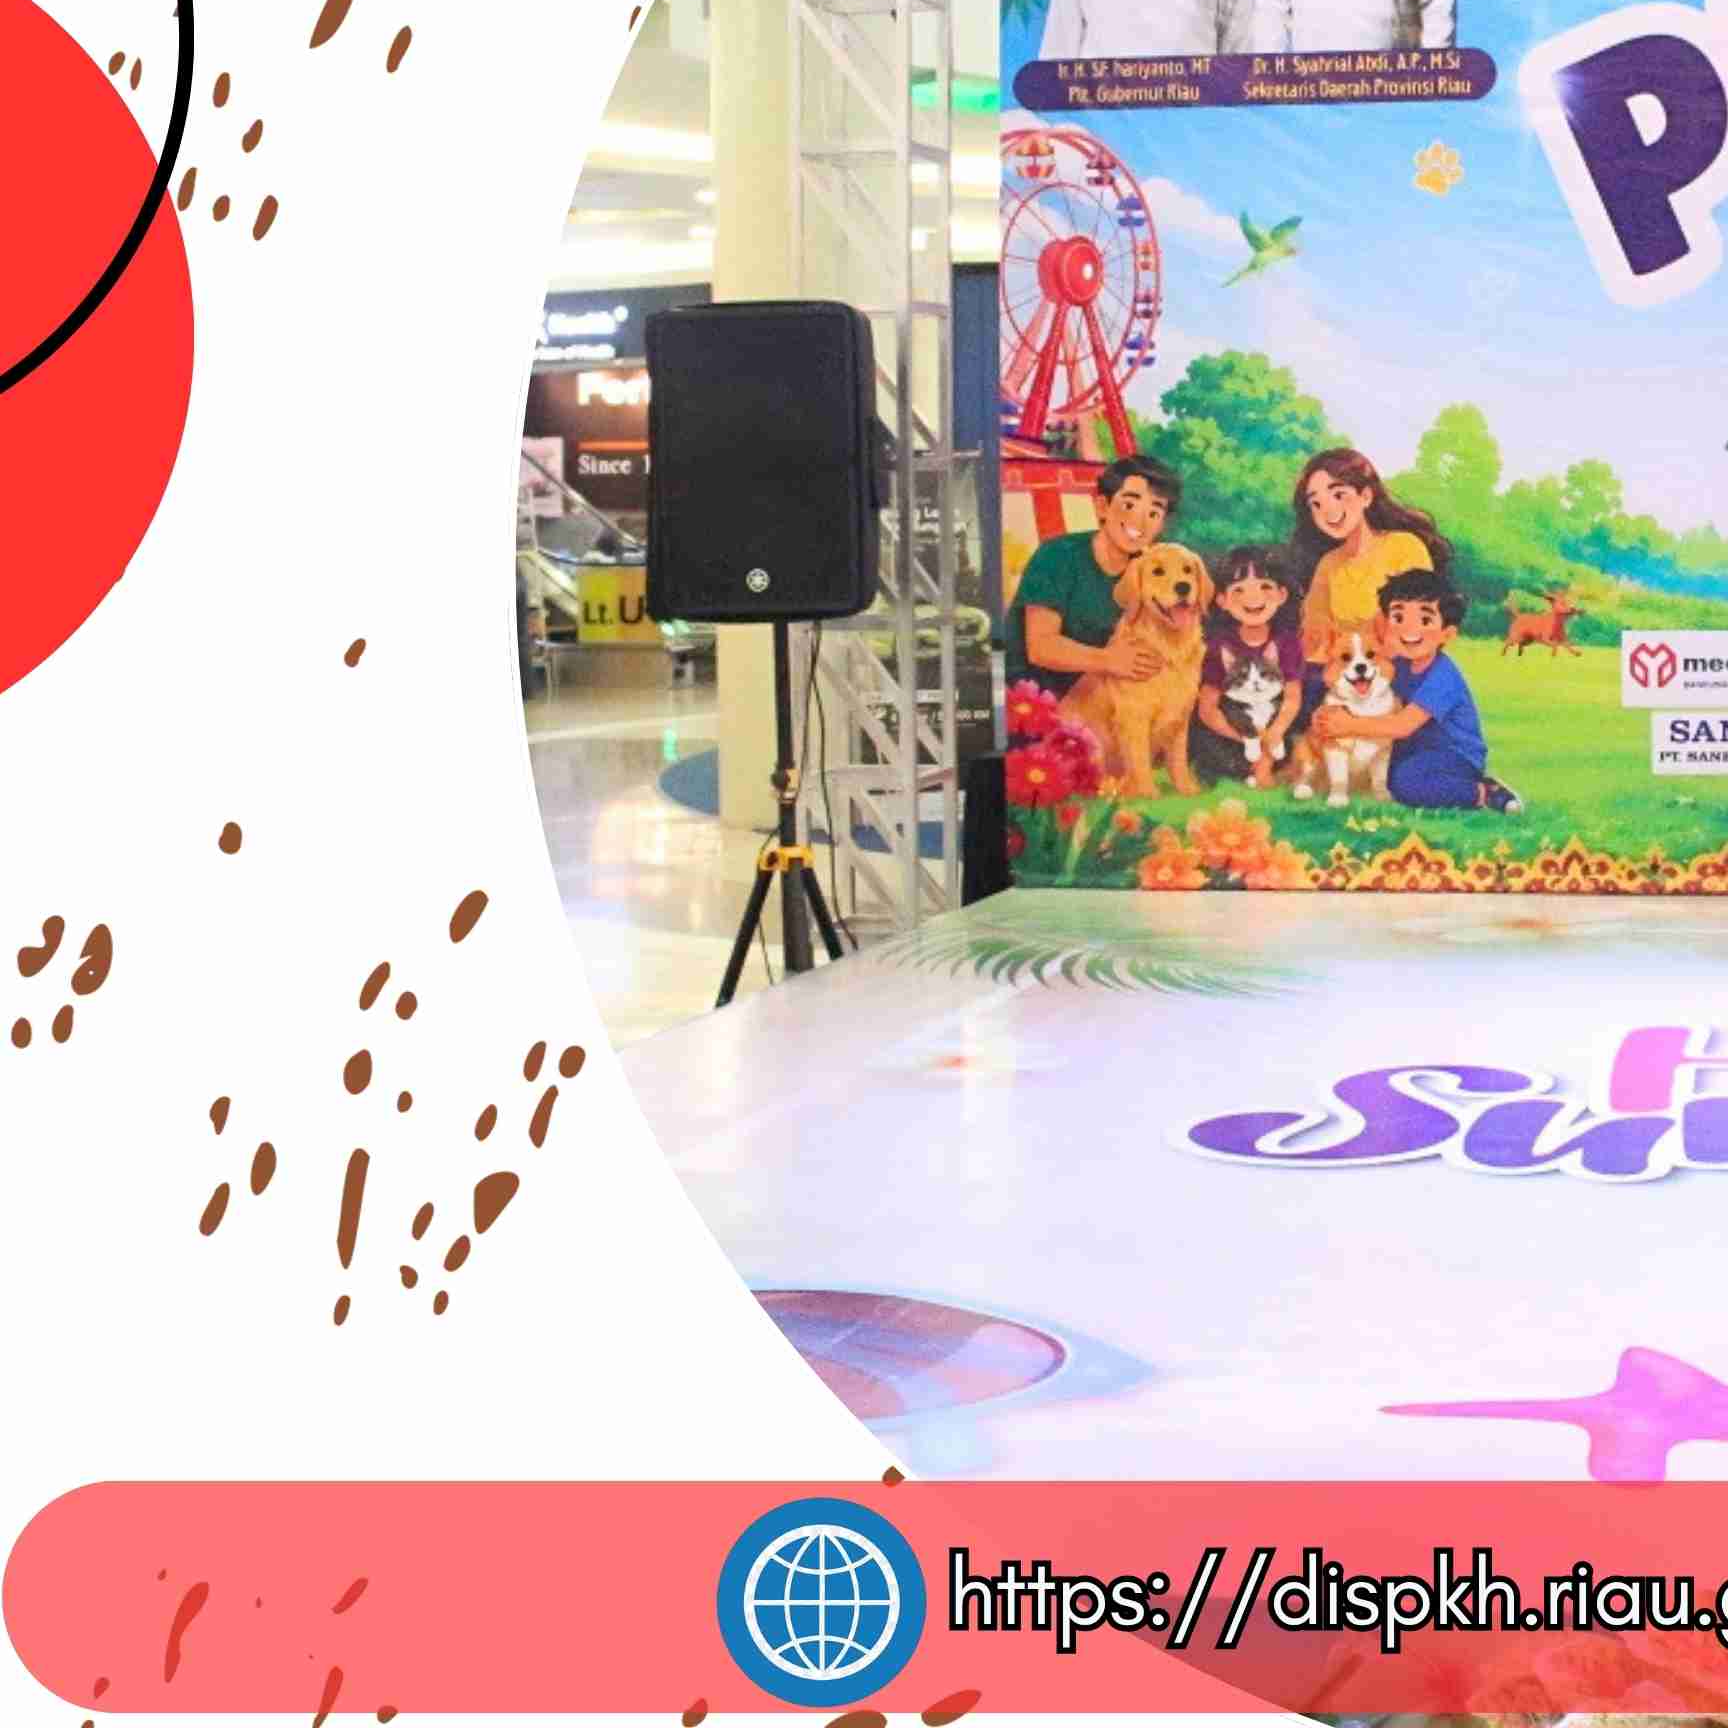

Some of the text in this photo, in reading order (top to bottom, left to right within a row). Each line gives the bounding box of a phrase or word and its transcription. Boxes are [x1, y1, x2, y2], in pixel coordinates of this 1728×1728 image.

[1293, 55, 1352, 77] Syahrial
[1165, 81, 1201, 102] Riau
[1242, 75, 1473, 101] Sekretaris Daerah Provinsi Riau
[577, 454, 632, 476] Since
